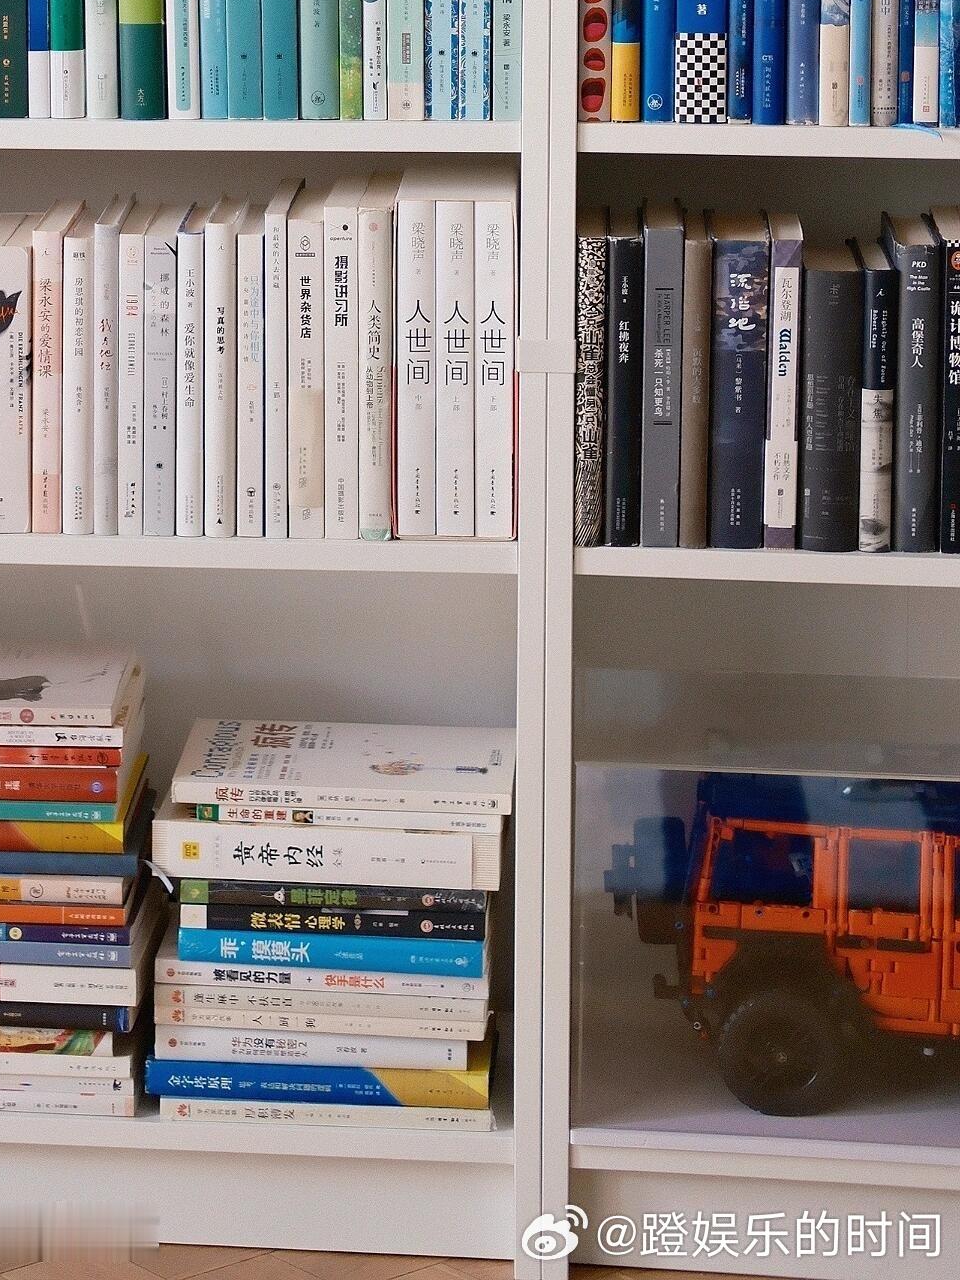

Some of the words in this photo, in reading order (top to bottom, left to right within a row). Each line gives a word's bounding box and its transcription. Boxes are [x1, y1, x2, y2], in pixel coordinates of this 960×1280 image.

[503, 13, 511, 37] 梁永安
[696, 4, 708, 15] 著
[503, 39, 511, 47] 著
[272, 227, 280, 289] 和最爱的人去西藏
[411, 222, 425, 262] 梁晓声
[449, 223, 464, 263] 梁晓声
[486, 223, 500, 263] 梁晓声
[185, 269, 196, 298] 王小波
[911, 261, 927, 269] PKD
[126, 294, 139, 316] 1984
[160, 273, 170, 337] 挪威的森林
[300, 275, 312, 339] 世界杂货店
[334, 255, 349, 327] 摄影讲习所
[664, 293, 673, 322] HARPER
[728, 273, 756, 331] 流俗地
[781, 277, 793, 322] 瓦尔登湖
[39, 277, 54, 378] 梁永安的爱情课
[74, 277, 85, 357] 房思琪的初恋乐园
[216, 306, 225, 355] 写真的思考
[251, 275, 260, 363] 只为途中与你相见
[368, 300, 382, 360] 人类简史
[664, 327, 672, 344] LEE
[99, 318, 114, 371] 我与地坛
[405, 299, 432, 386] 人世间
[443, 300, 471, 387] 人世间
[480, 300, 507, 387] 人世间
[618, 320, 630, 364] 红拂夜奔
[778, 328, 792, 377] Walden
[911, 317, 925, 368] 高堡奇人
[184, 322, 196, 408] 爱你就像爱生命
[653, 348, 664, 417] 杀死一只知更鸟
[872, 393, 884, 420] 失焦
[251, 723, 298, 749] 疯传
[214, 786, 246, 802] 疯传
[227, 810, 288, 820] 生命的重建
[233, 841, 324, 868] 黄帝内经
[250, 911, 346, 931] 微表情心理学
[220, 936, 311, 963] 乖，摸摸头
[212, 968, 292, 985] 被看见的力量
[324, 973, 385, 989] 快手是什么
[231, 1036, 308, 1050] 华为没有秘密2
[167, 1074, 233, 1091] 金字塔原理
